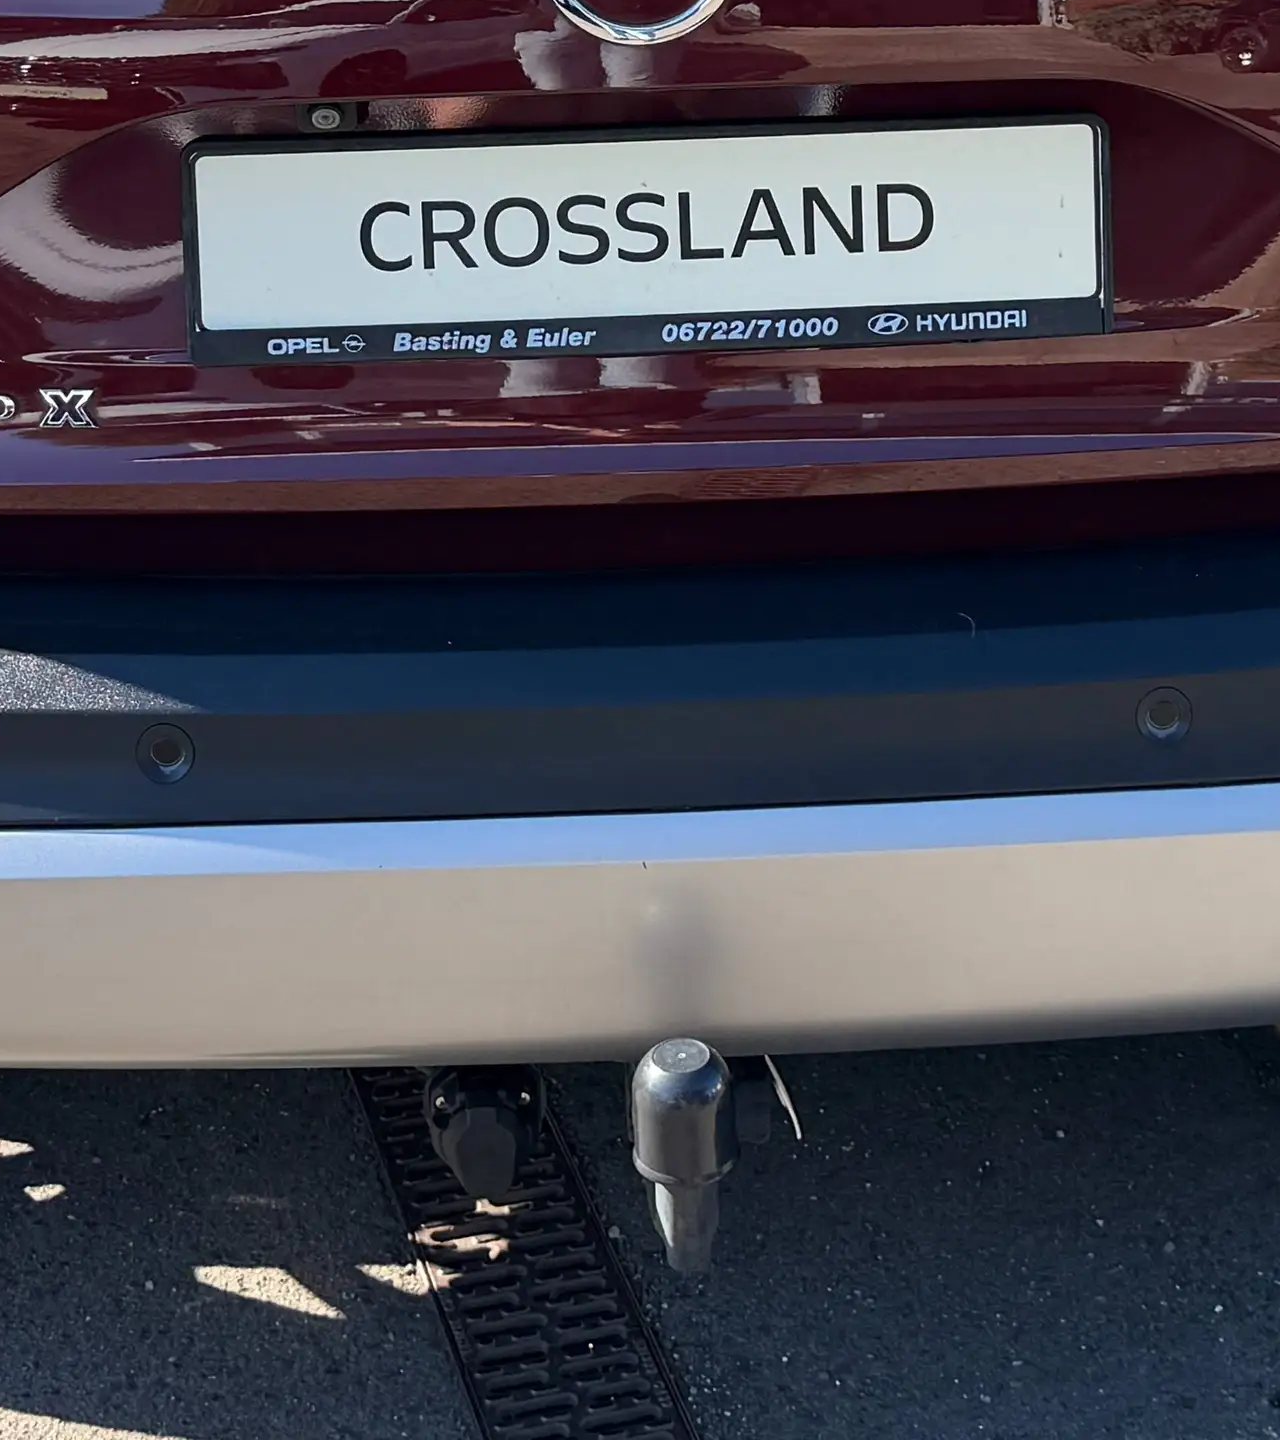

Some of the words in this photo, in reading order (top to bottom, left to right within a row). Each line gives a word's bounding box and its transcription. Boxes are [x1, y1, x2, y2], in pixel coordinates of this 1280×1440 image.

[359, 183, 934, 271] CROSSLAND
[267, 338, 339, 355] OPEL
[393, 330, 491, 353] Basting
[500, 328, 517, 348] &
[526, 327, 596, 348] Euler
[661, 316, 839, 342] 06722/71000
[917, 310, 1028, 331] HYUNDAI
[38, 388, 99, 428] X
